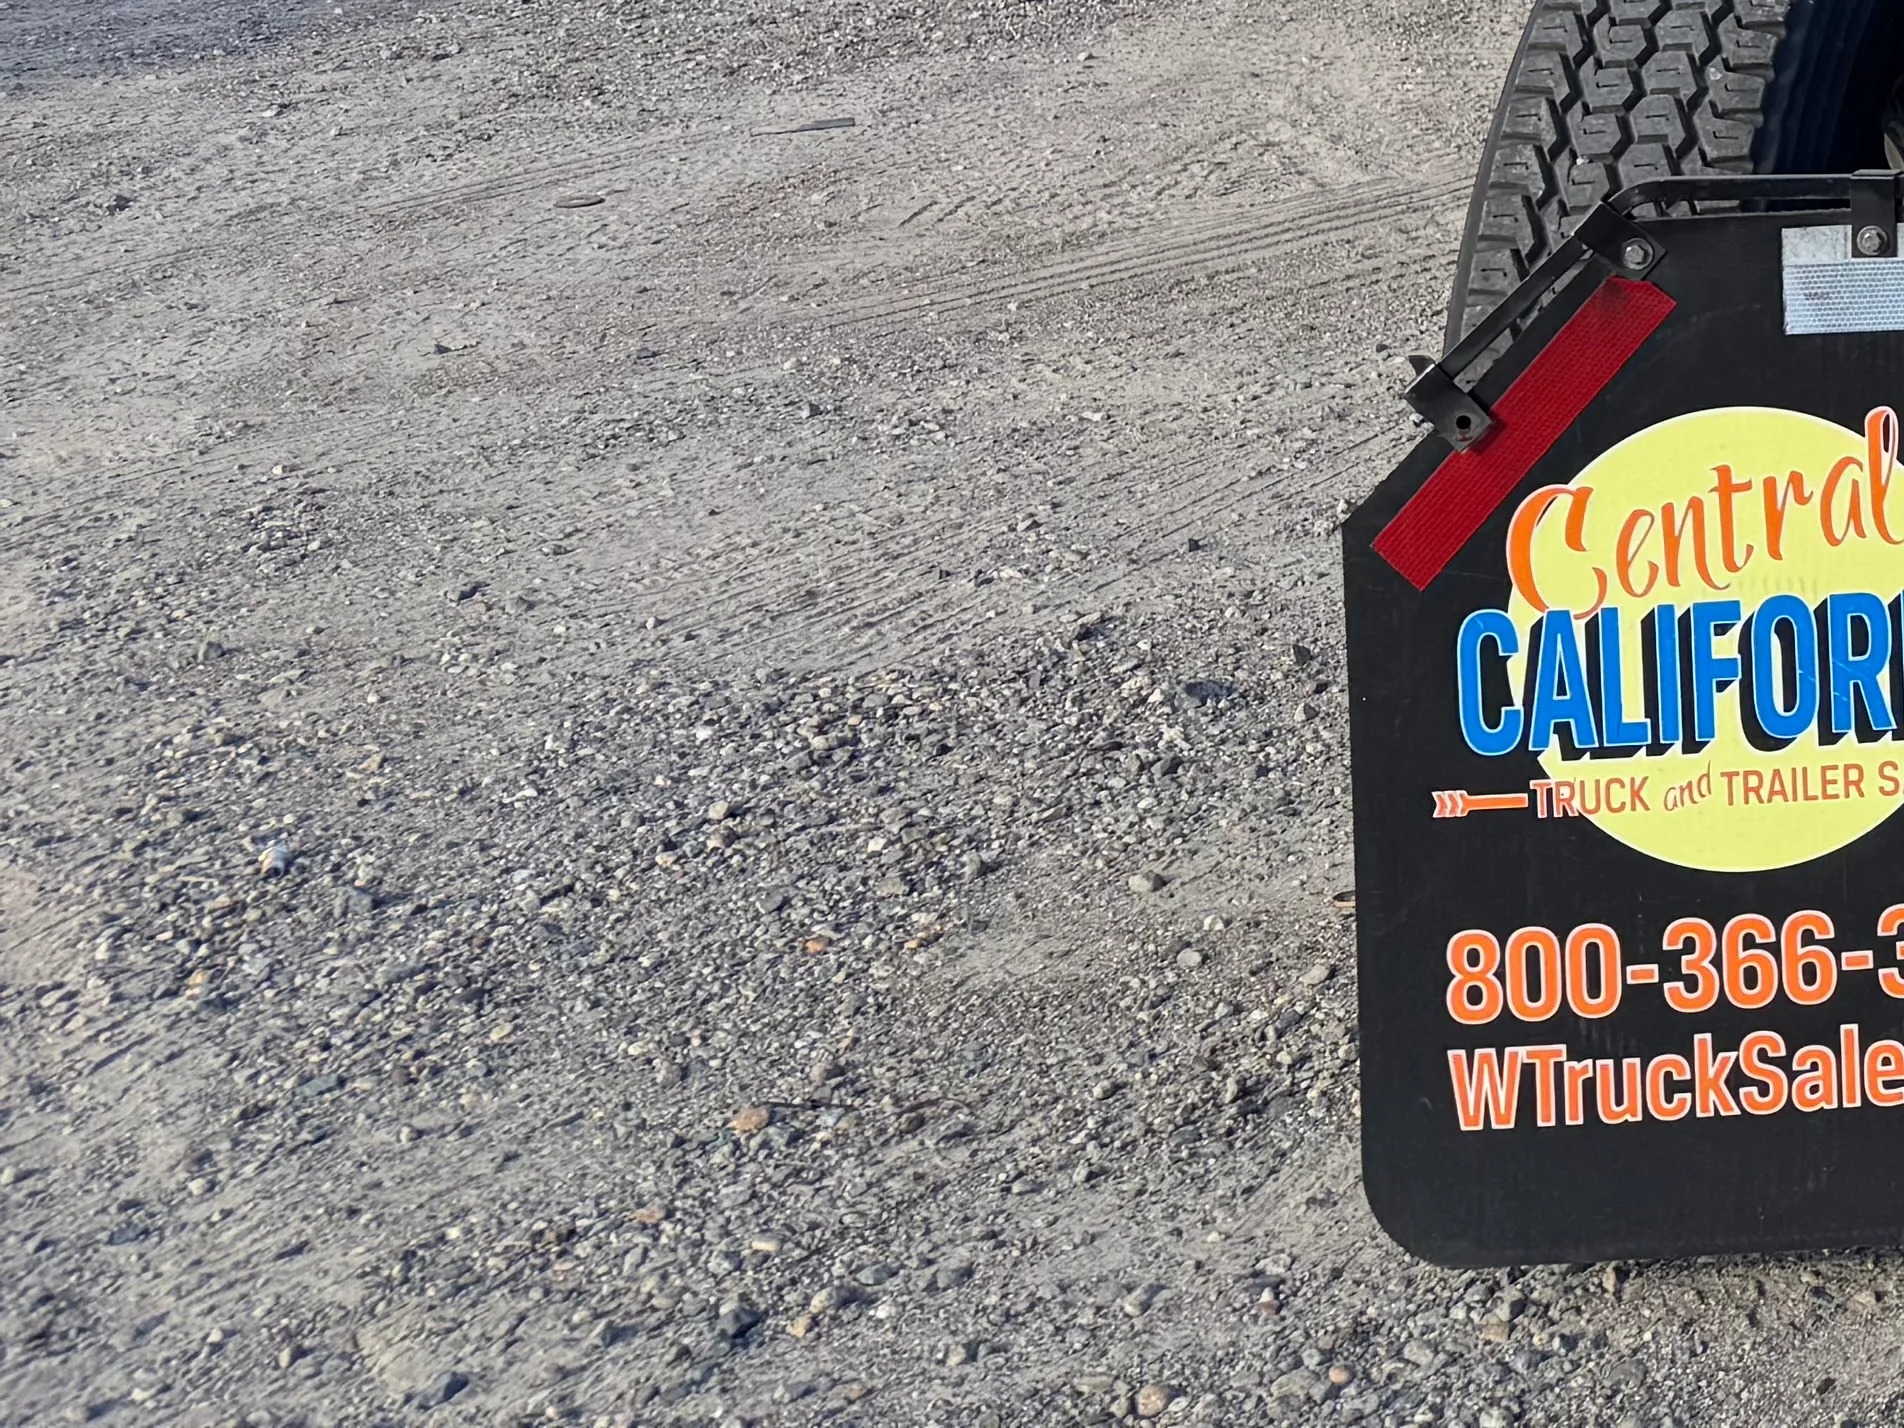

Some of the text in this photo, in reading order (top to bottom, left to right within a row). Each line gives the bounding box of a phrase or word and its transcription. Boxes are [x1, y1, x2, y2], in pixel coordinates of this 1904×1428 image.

[1528, 775, 1651, 820] TRUCK
[1662, 761, 1713, 813] and
[1719, 762, 1866, 806] TRAILER
